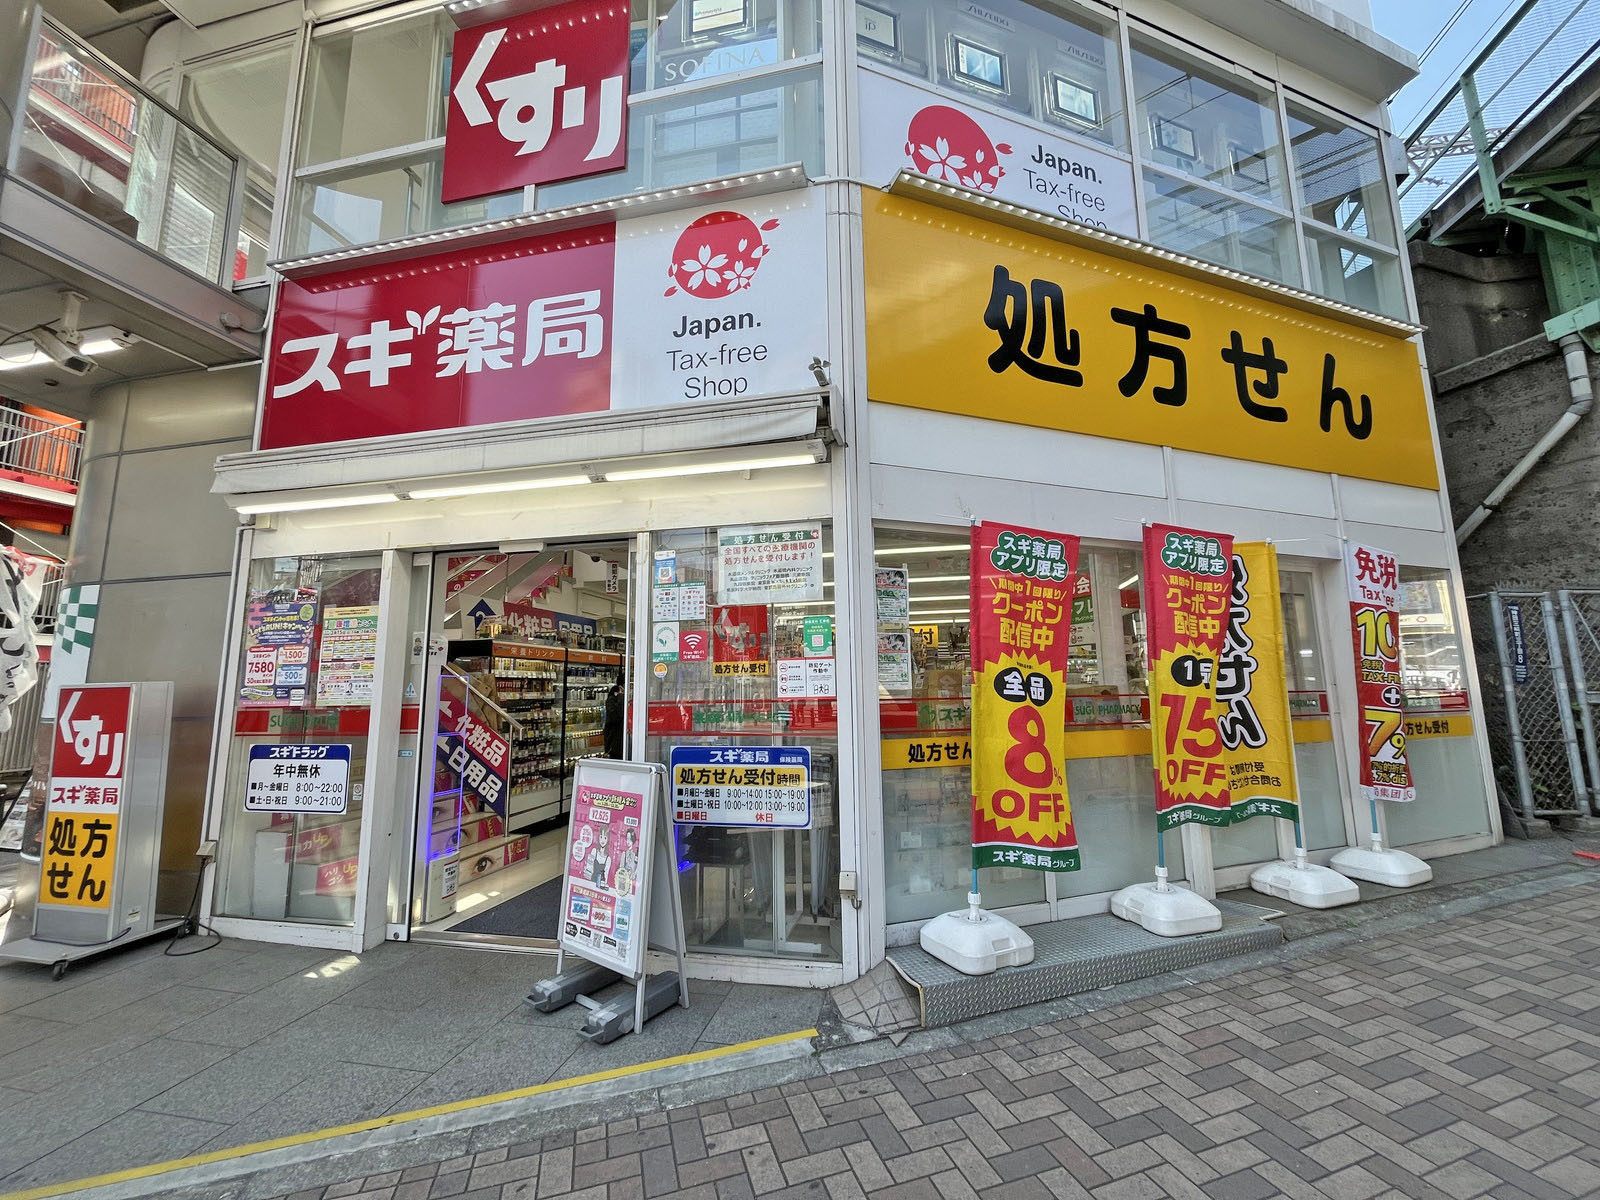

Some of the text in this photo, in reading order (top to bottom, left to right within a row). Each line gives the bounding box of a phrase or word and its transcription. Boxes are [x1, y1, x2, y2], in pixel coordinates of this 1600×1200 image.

[664, 47, 766, 82] SOFINA
[453, 28, 623, 161] くすり
[1031, 144, 1103, 185] Japan.
[1023, 168, 1105, 212] Tax-free
[672, 311, 762, 341] Japan.
[273, 289, 603, 399] スギ薬局
[666, 341, 768, 371] Tax-free
[983, 264, 1373, 441] 処方せん
[684, 374, 748, 398] Shop
[724, 541, 816, 556] 全国すべての医療機関の
[734, 531, 804, 545] 処方せん受付
[1003, 536, 1062, 561] スギ薬局
[1169, 537, 1218, 557] スギ薬局
[996, 551, 1067, 578] アプリ限定
[1165, 551, 1225, 573] アプリ限定
[1354, 547, 1397, 590] 免税
[998, 577, 1062, 600] 期間中1回限り
[1166, 588, 1226, 615] クーポン
[1359, 585, 1381, 601] Tax
[992, 592, 1063, 625] クーポン
[1000, 617, 1054, 652] 配信中
[1174, 610, 1221, 640] 配信中
[714, 662, 767, 675] 処方せん受付
[1003, 671, 1044, 701] 全品
[1075, 705, 1095, 716] SUGI
[59, 691, 124, 776] くすり
[454, 713, 507, 768] 化粧品
[269, 745, 329, 758] スギドラッグ
[709, 748, 769, 763] スギ薬局
[273, 763, 321, 779] 年中無休
[448, 745, 503, 804] 日用品
[1166, 759, 1227, 786] OFF
[52, 784, 119, 806] スギ薬局
[992, 789, 1065, 823] OFF
[684, 811, 774, 822] 日曜日 休日
[48, 817, 112, 859] 処方
[992, 850, 1075, 868] スギ薬局グループ
[47, 862, 107, 902] せん
